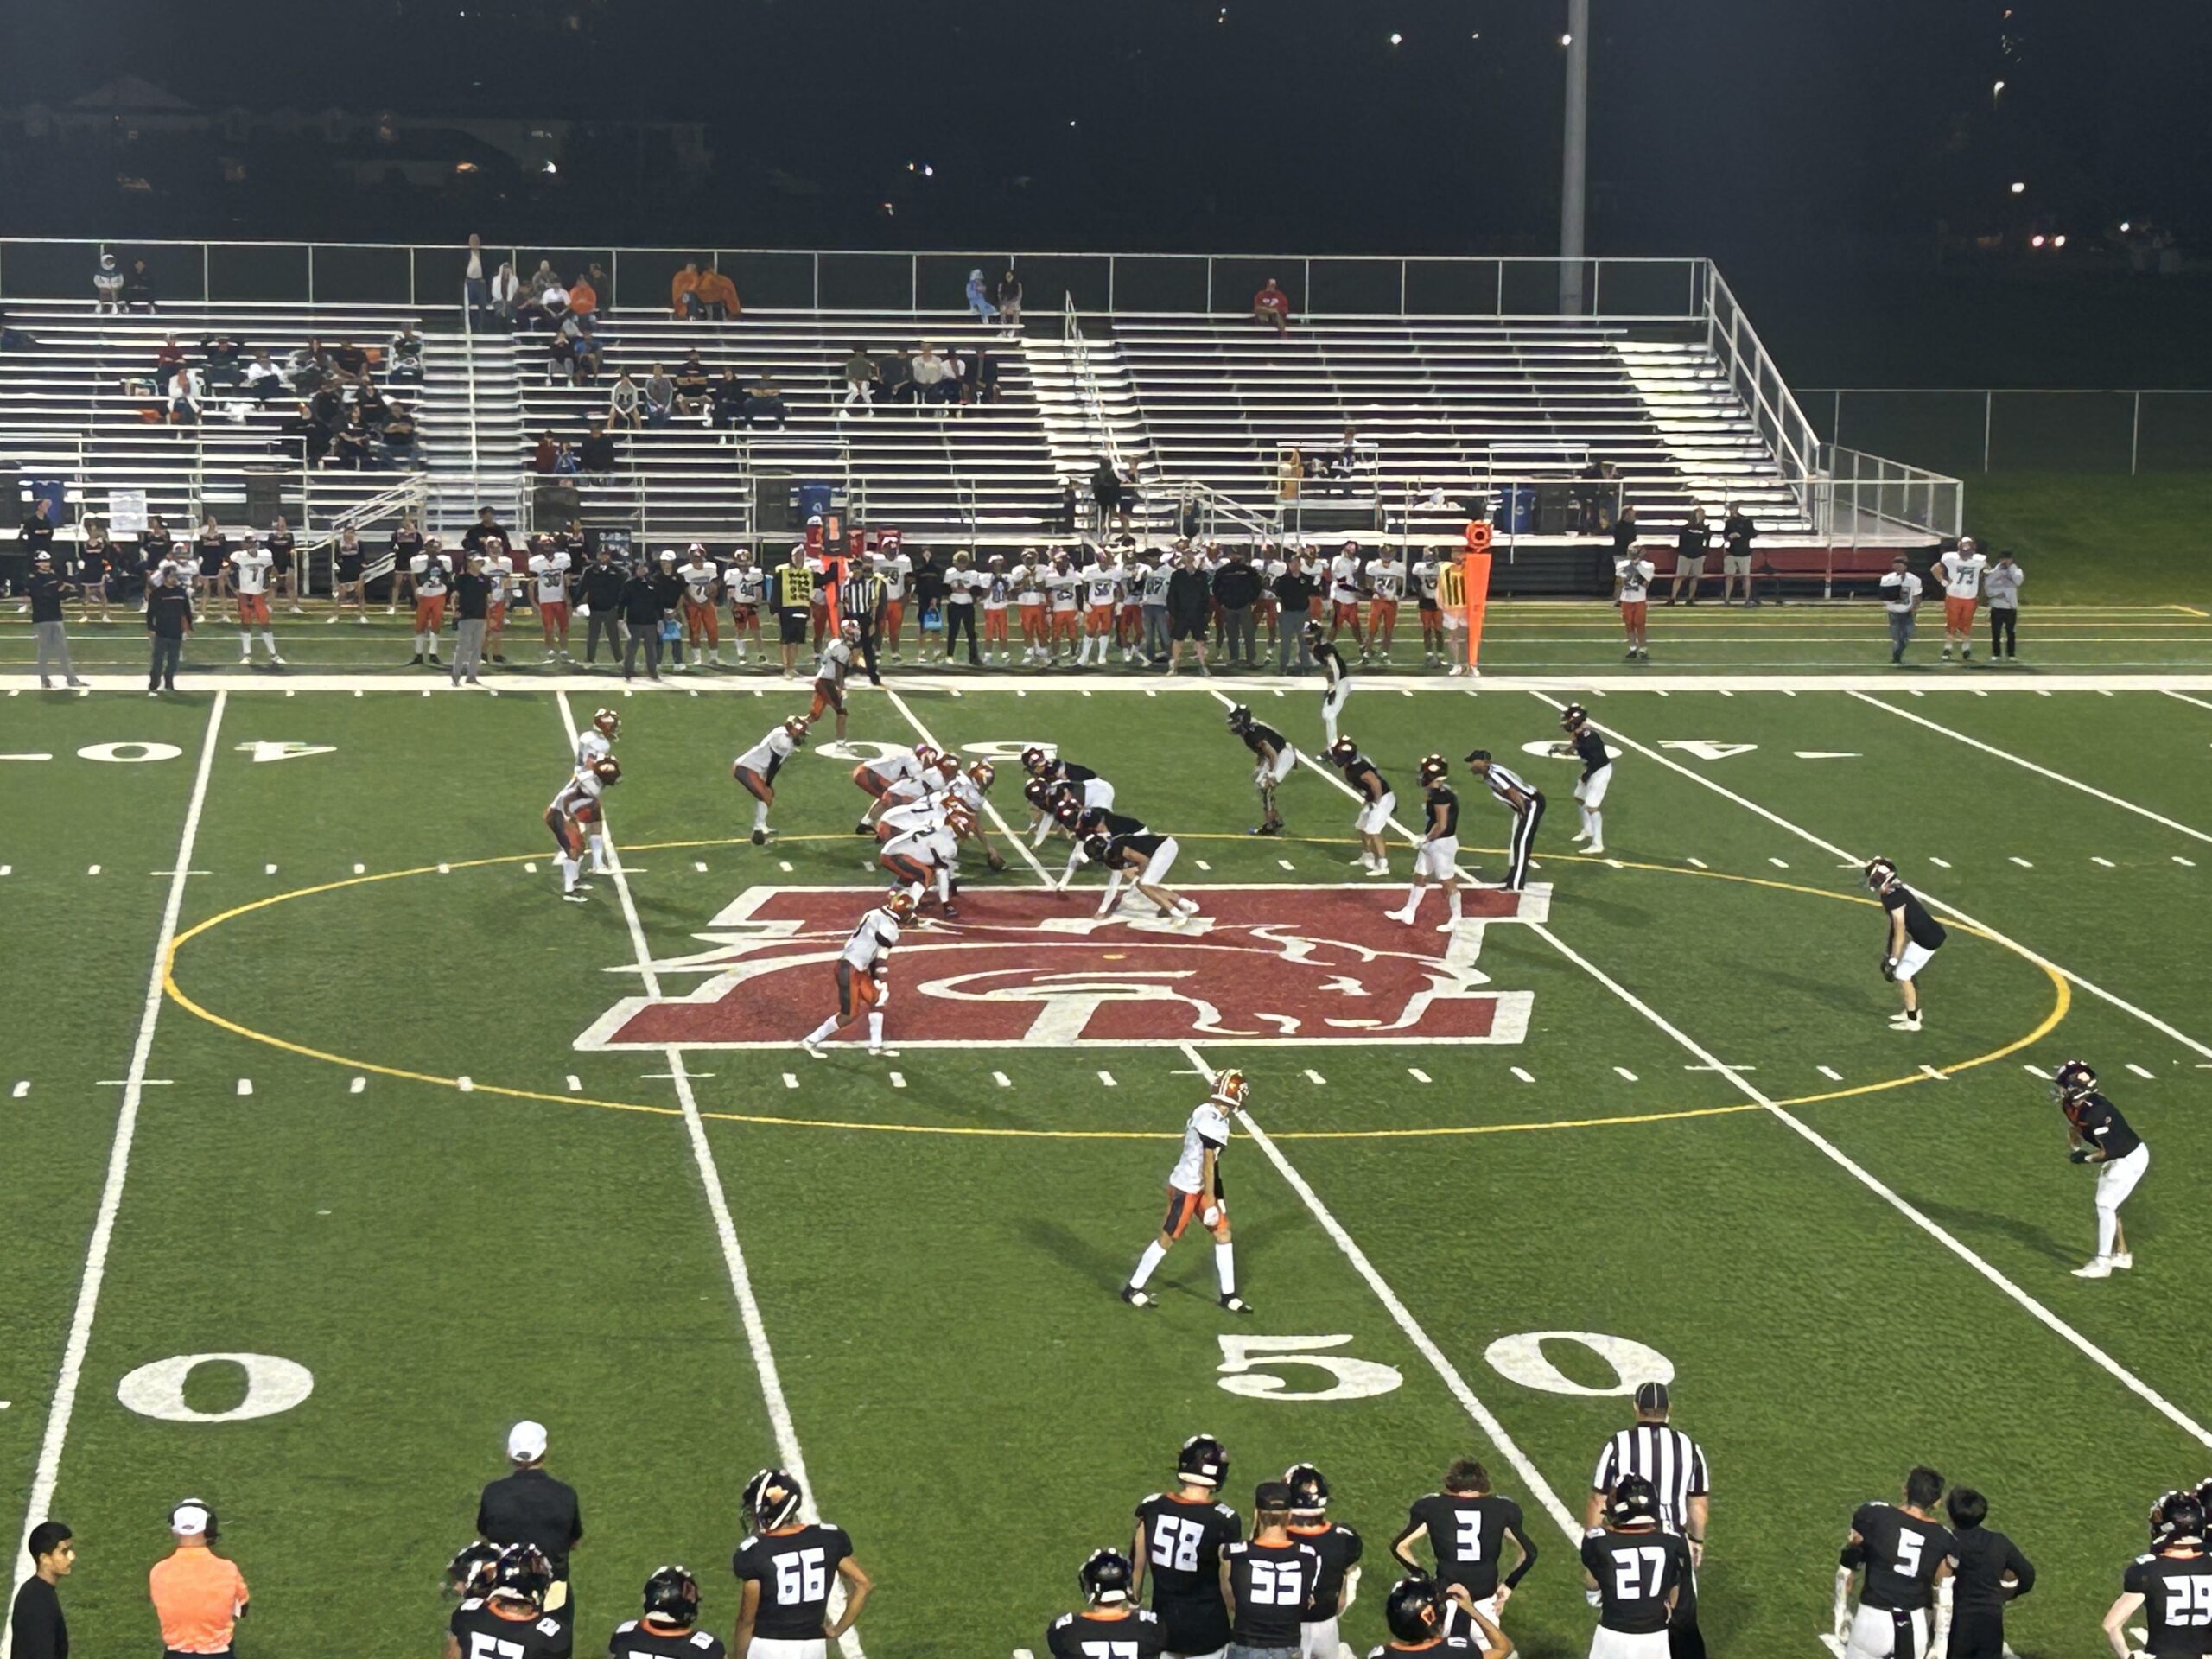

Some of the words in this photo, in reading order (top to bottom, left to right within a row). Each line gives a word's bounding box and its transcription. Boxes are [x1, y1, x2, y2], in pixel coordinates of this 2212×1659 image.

[117, 1353, 314, 1422] 0
[1152, 1514, 1205, 1572] 58
[1454, 1510, 1481, 1561] 3
[1893, 1528, 1925, 1578] 5
[772, 1547, 825, 1605] 66
[1249, 1560, 1302, 1605] 55
[1611, 1546, 1667, 1599] 27
[2163, 1575, 2212, 1626] 29
